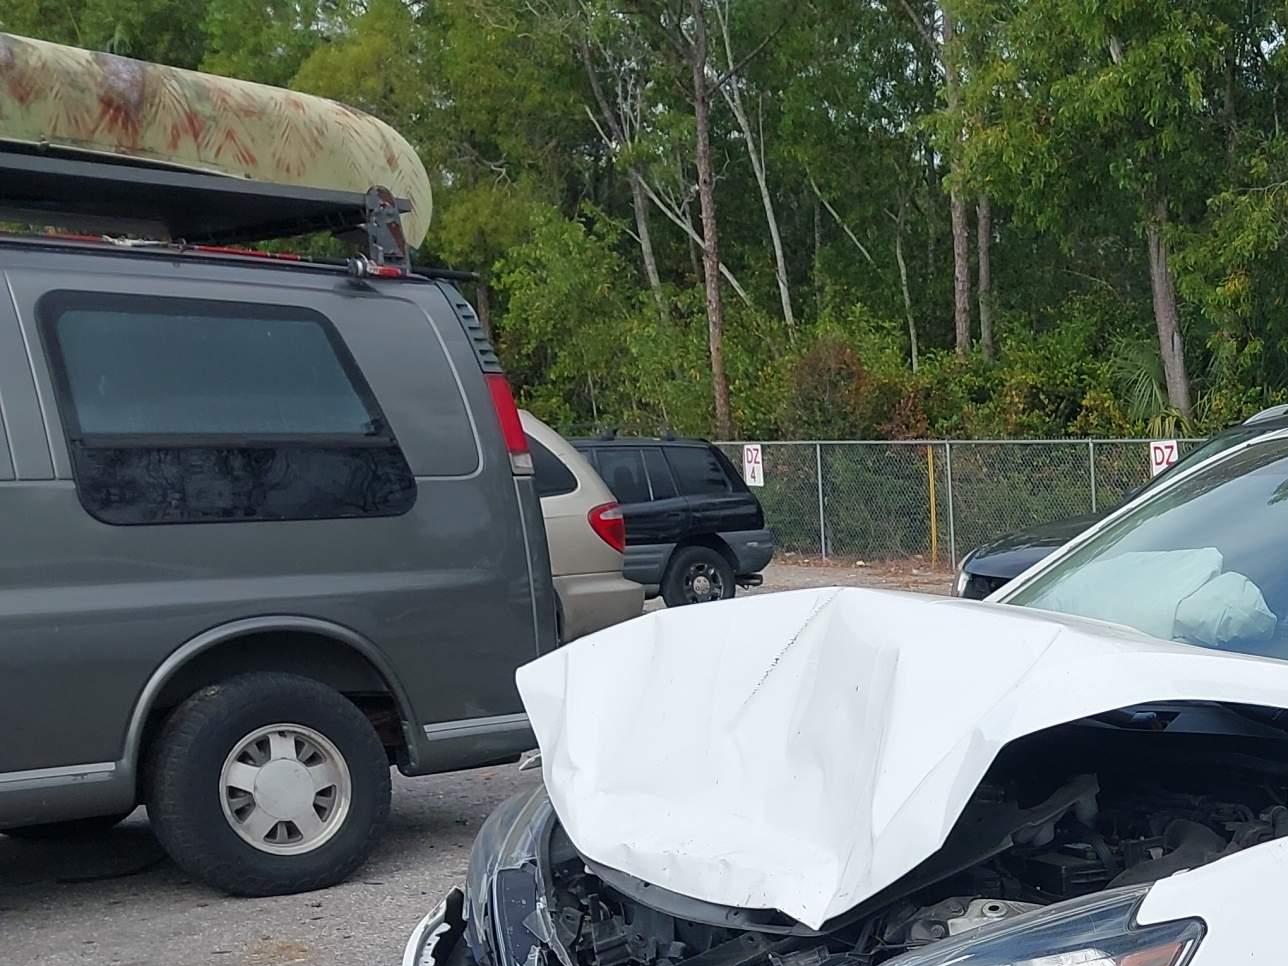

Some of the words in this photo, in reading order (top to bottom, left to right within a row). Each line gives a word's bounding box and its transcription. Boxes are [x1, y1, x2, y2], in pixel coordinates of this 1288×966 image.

[746, 448, 760, 464] DZ
[1153, 445, 1175, 466] DZ
[750, 466, 756, 482] 4
